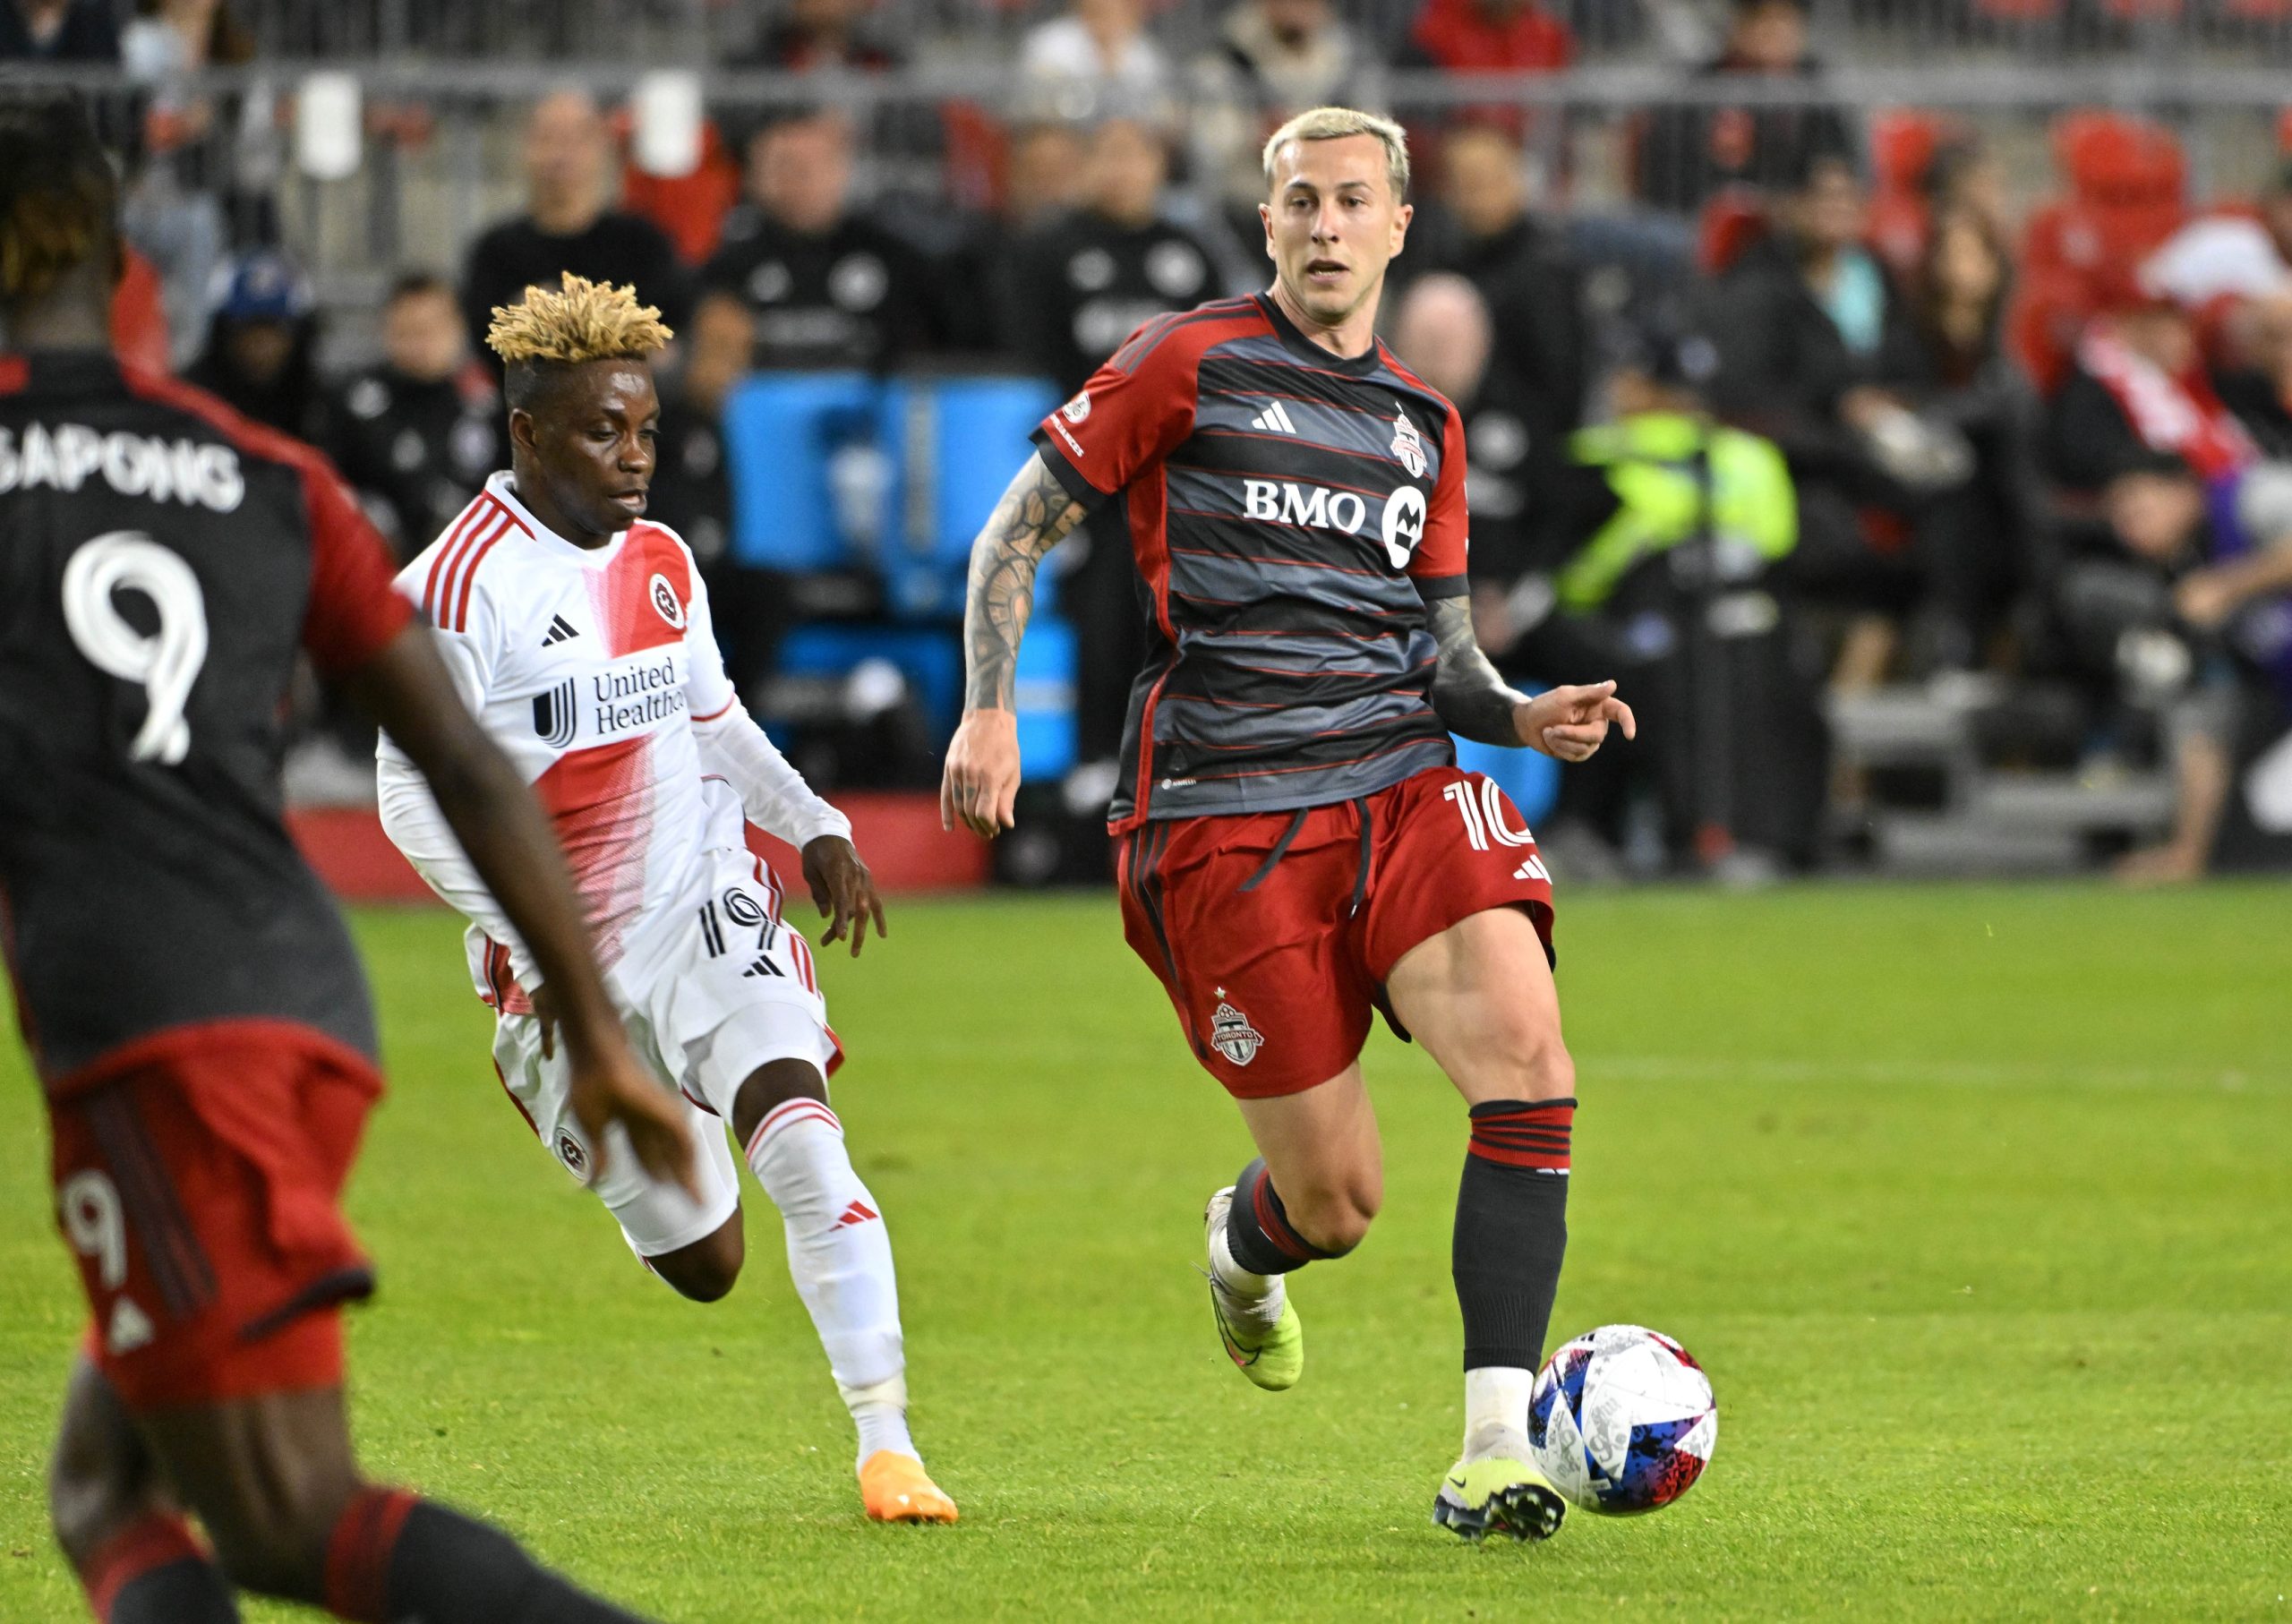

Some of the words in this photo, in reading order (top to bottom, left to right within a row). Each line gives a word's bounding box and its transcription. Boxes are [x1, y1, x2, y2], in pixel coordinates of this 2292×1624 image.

[1243, 479, 1366, 534] BMO
[61, 530, 210, 766] 9
[593, 656, 675, 702] United
[1442, 776, 1535, 850] 10
[699, 887, 777, 959] 19
[1217, 1030, 1253, 1042] TORONTO
[63, 1167, 129, 1290] 9
